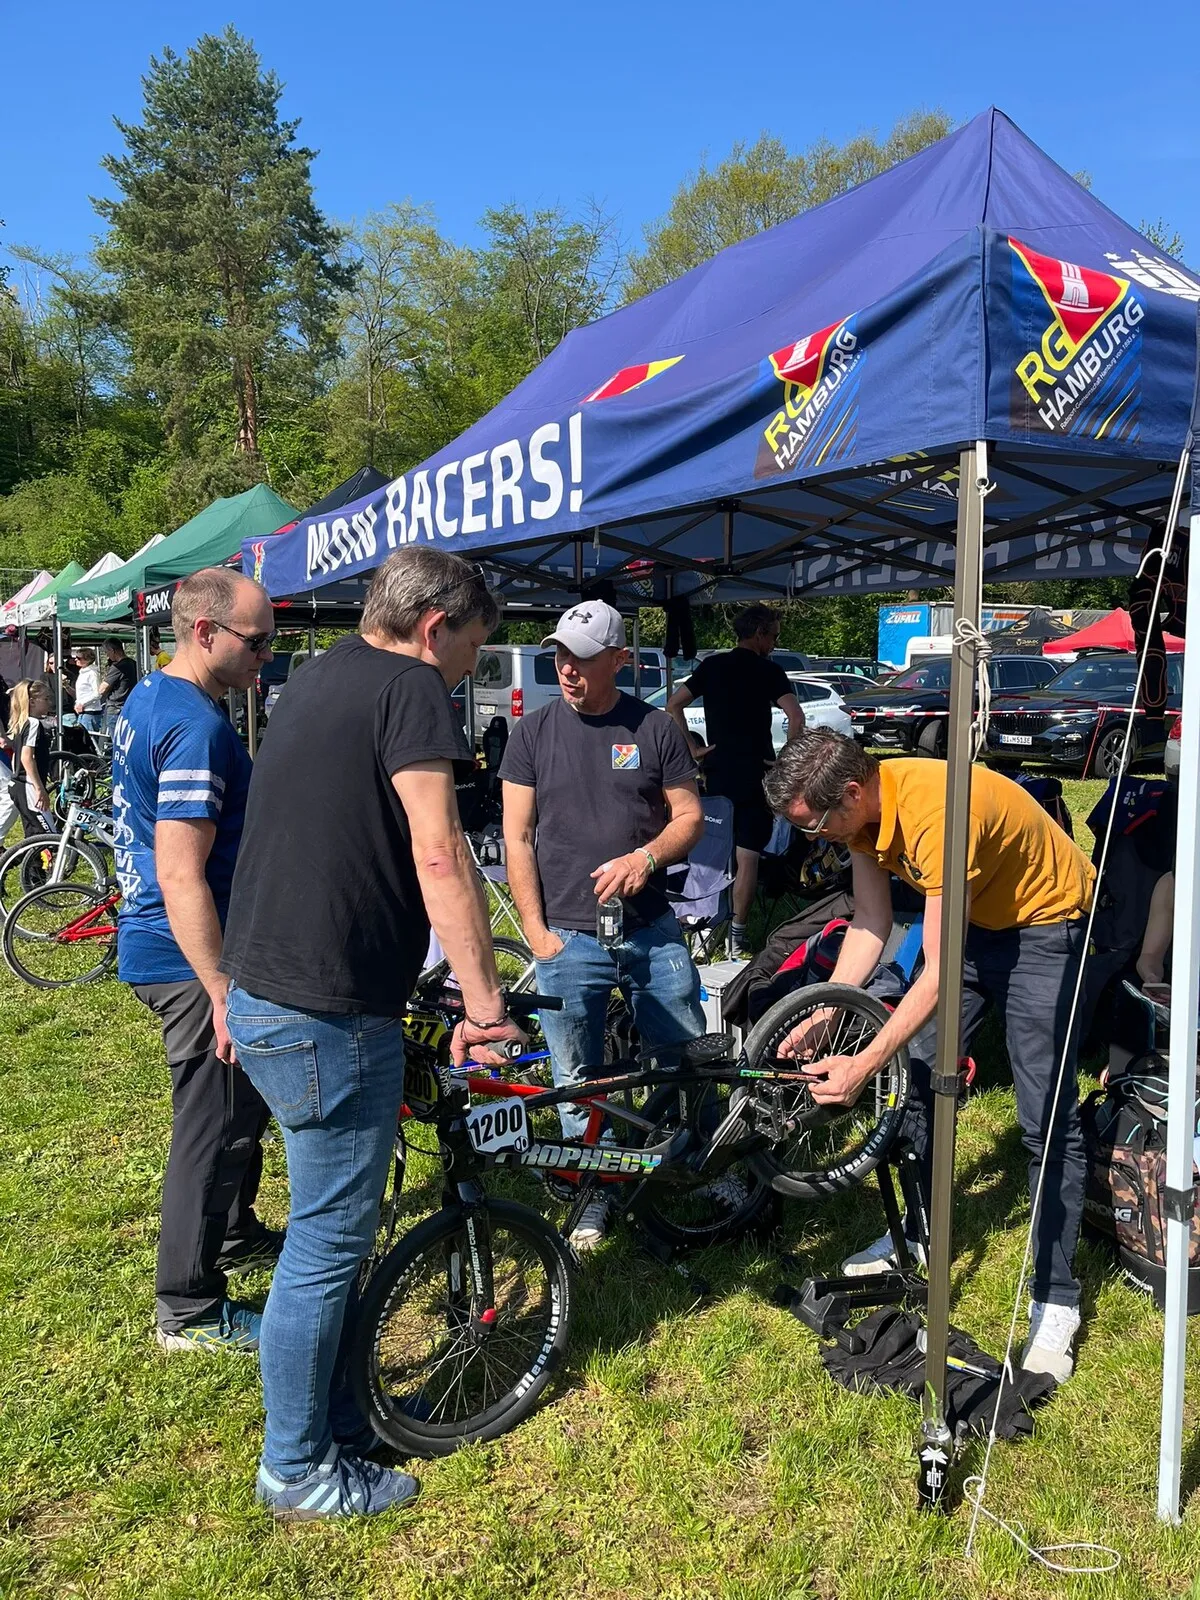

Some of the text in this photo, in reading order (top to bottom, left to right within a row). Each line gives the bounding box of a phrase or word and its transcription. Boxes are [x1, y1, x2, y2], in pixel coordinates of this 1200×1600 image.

[774, 326, 858, 470] HAMBURG
[1038, 296, 1145, 430] HAMBURG
[385, 411, 584, 549] RACERS!
[146, 590, 171, 614] 24MX
[469, 1103, 523, 1148] 1200
[515, 1303, 561, 1399] alienation
